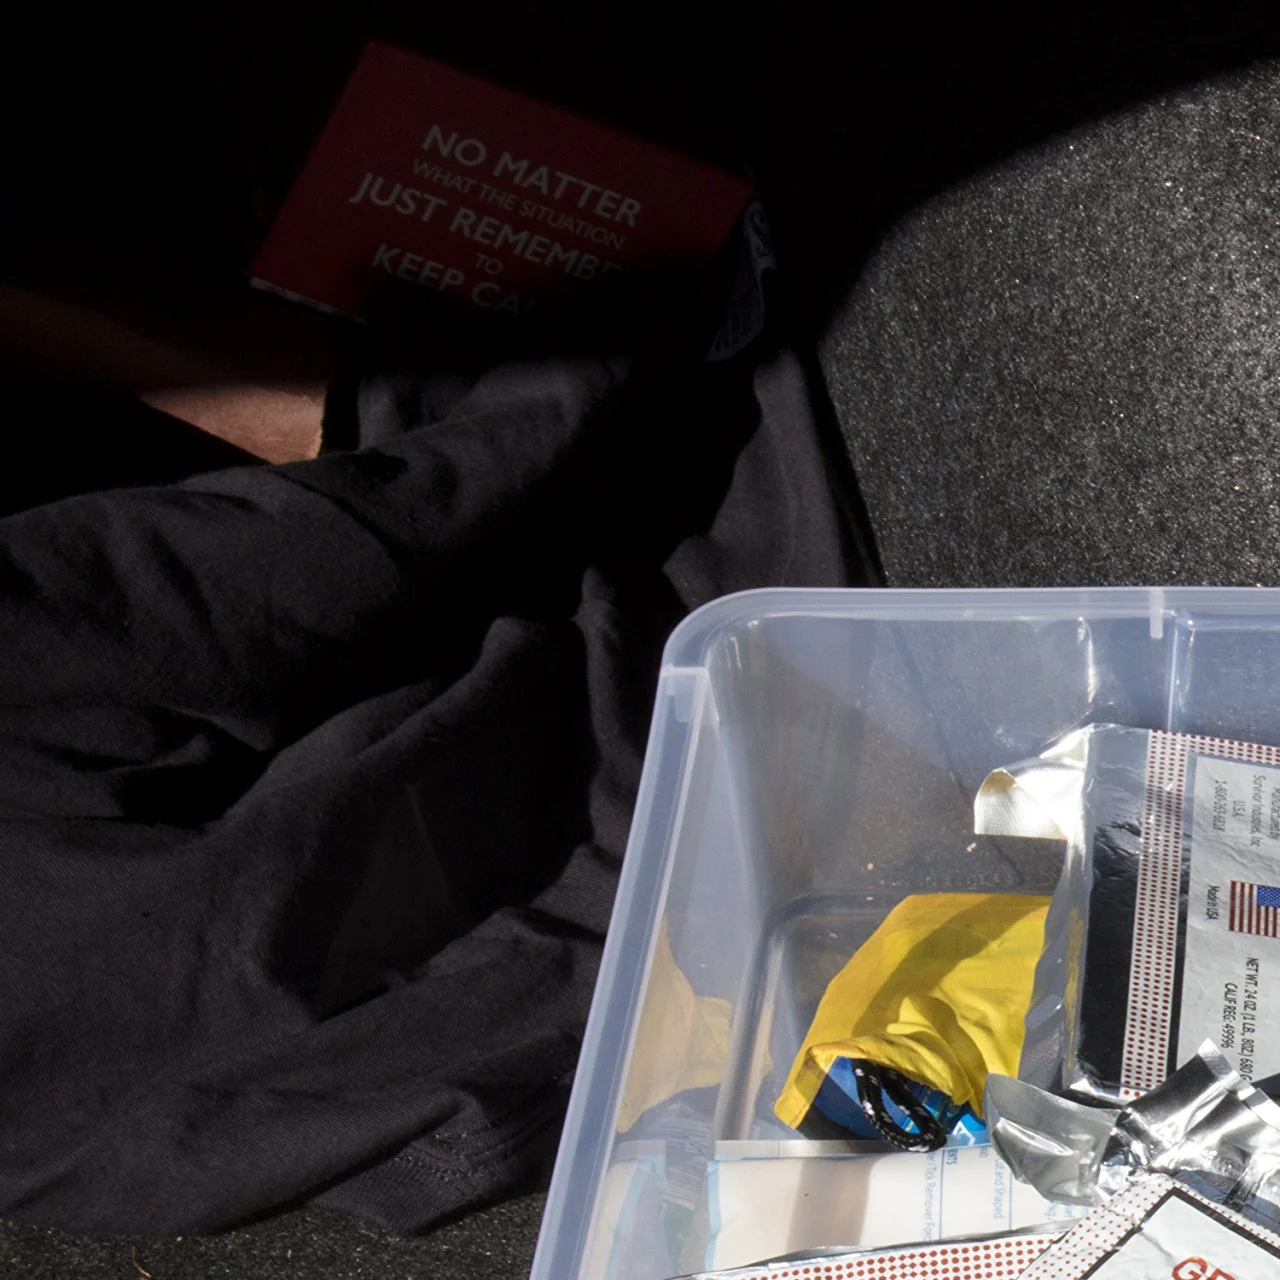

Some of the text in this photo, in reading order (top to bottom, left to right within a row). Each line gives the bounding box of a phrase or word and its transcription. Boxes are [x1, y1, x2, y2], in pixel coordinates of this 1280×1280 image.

[348, 171, 448, 223] JUST
[413, 160, 625, 250] WHAT THE SITUATION
[422, 124, 642, 228] NO MATTER
[370, 241, 466, 292] KEEP
[475, 252, 504, 275] TO
[1220, 981, 1238, 1048] CALIF REG: 49996
